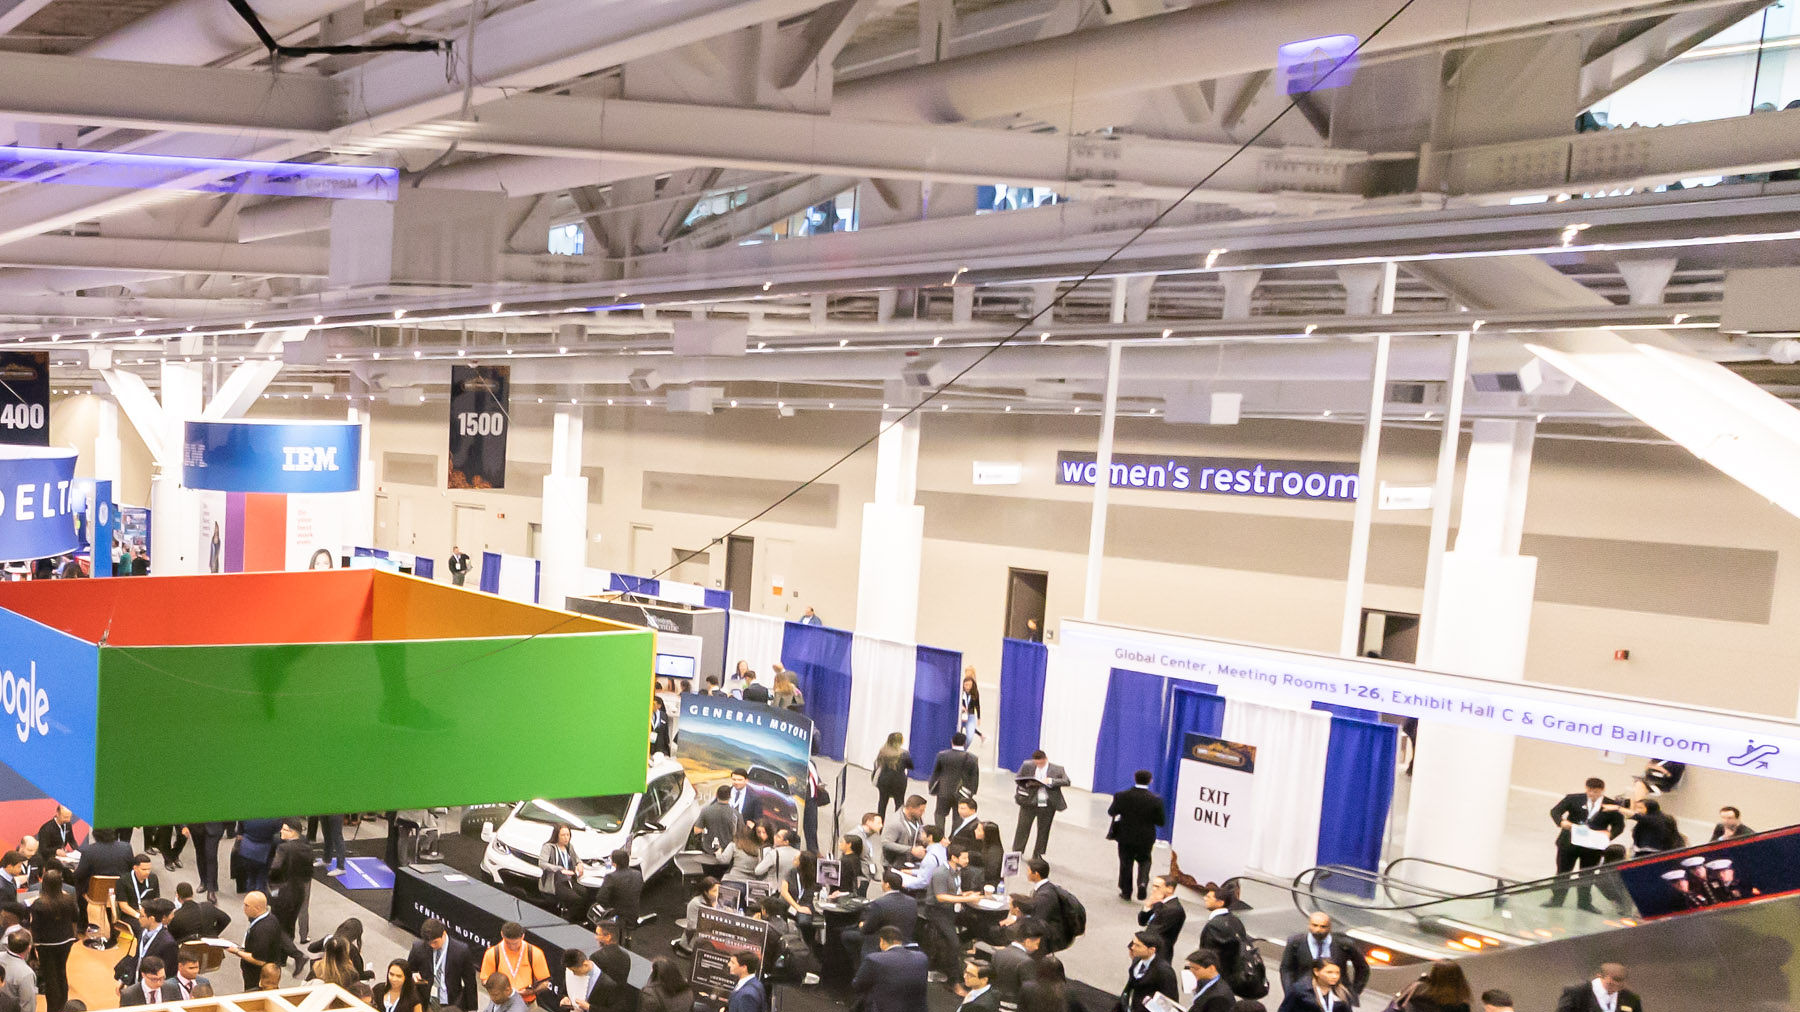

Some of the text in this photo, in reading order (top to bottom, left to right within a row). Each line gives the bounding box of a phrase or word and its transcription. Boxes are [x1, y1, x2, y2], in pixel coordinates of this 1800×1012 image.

[458, 412, 503, 437] 1500
[282, 446, 340, 472] IBM
[1062, 459, 1359, 499] women's restroom
[1114, 647, 1156, 664] Global
[1217, 664, 1277, 686] Meeting
[1282, 673, 1338, 693] Rooms
[1343, 684, 1385, 702] 1-26,
[1392, 690, 1453, 713] Exhibit
[1460, 701, 1495, 719] Hall
[1502, 708, 1514, 722] C
[1521, 711, 1534, 725] &
[1542, 715, 1603, 737] Grand
[1611, 725, 1711, 754] Ballroom
[689, 704, 808, 741] GENERAL MOTORS
[1199, 786, 1230, 806] EXIT
[1194, 806, 1231, 828] ONLY
